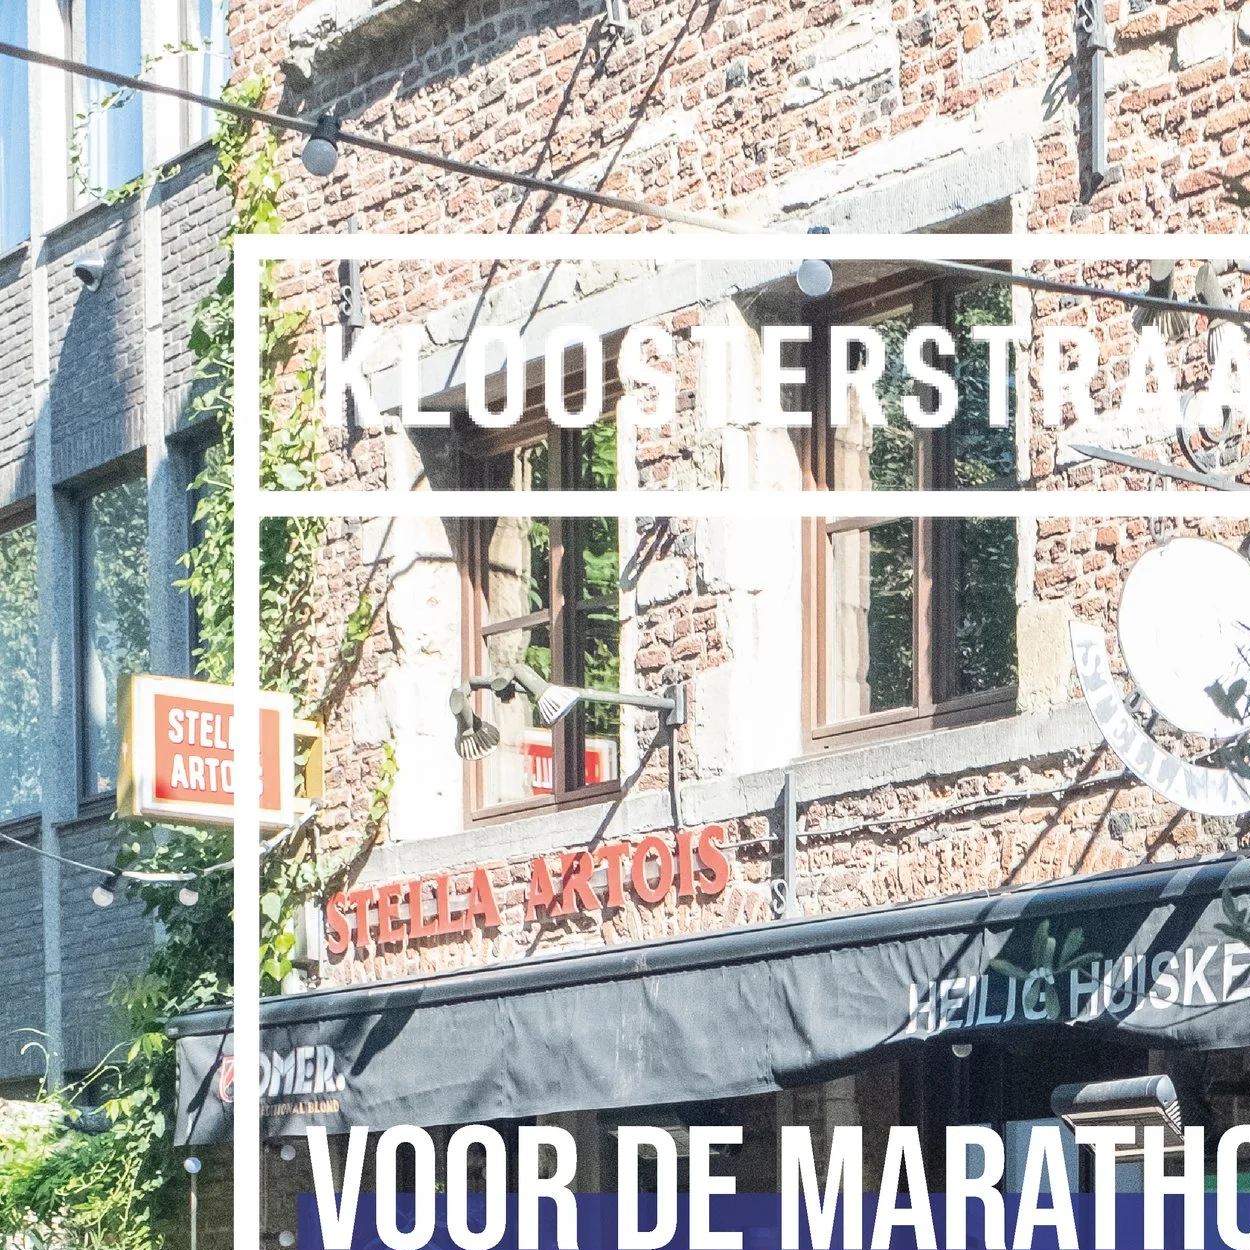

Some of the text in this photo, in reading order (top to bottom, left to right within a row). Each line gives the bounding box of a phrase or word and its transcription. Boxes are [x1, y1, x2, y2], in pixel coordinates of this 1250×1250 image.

[168, 708, 261, 754] STEL
[171, 754, 263, 797] ARTO
[325, 825, 731, 954] STELLA ARTOIS
[905, 966, 1055, 1034] HEILIG
